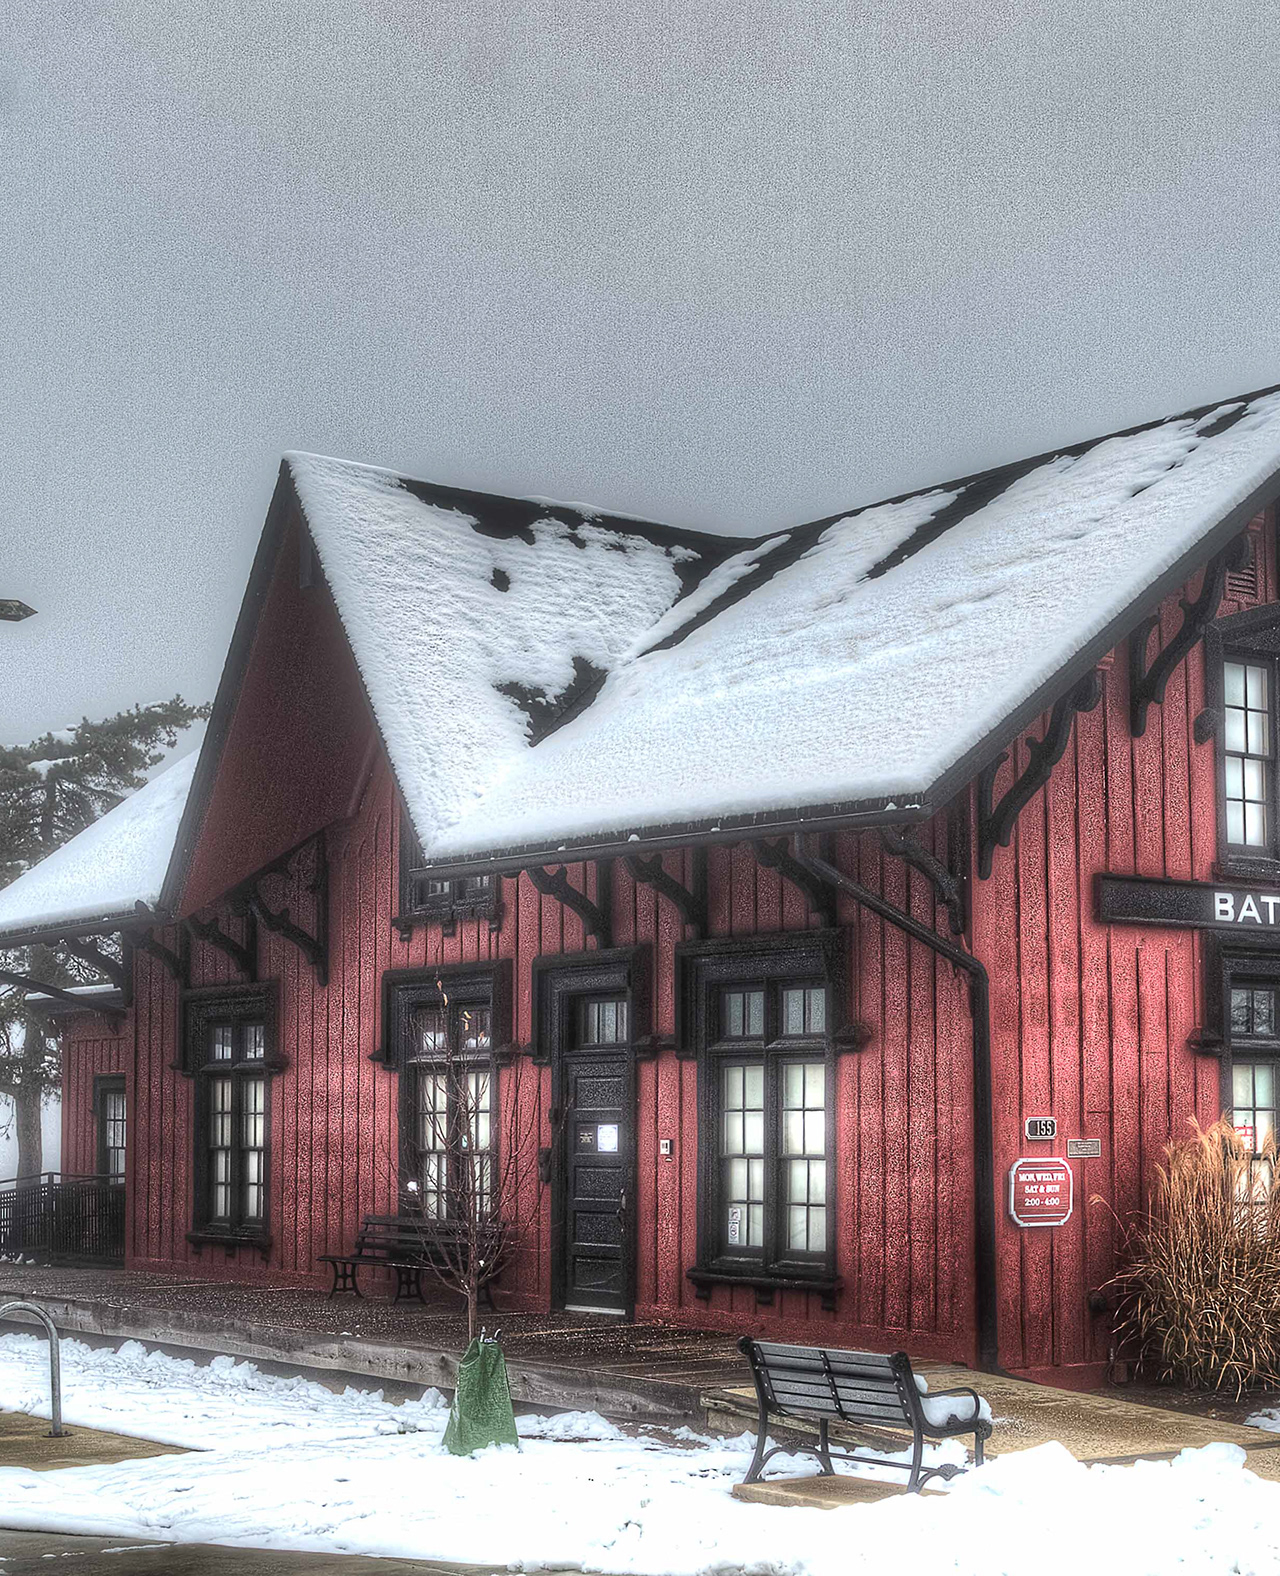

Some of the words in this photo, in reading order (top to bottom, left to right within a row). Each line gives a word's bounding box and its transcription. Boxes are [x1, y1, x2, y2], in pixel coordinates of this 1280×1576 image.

[1036, 1120, 1052, 1136] 155
[1024, 1185, 1039, 1194] SAT
[1039, 1185, 1045, 1193] &
[1046, 1184, 1060, 1193] SUN
[1024, 1198, 1040, 1206] 2:00
[1045, 1197, 1060, 1206] 4:00
